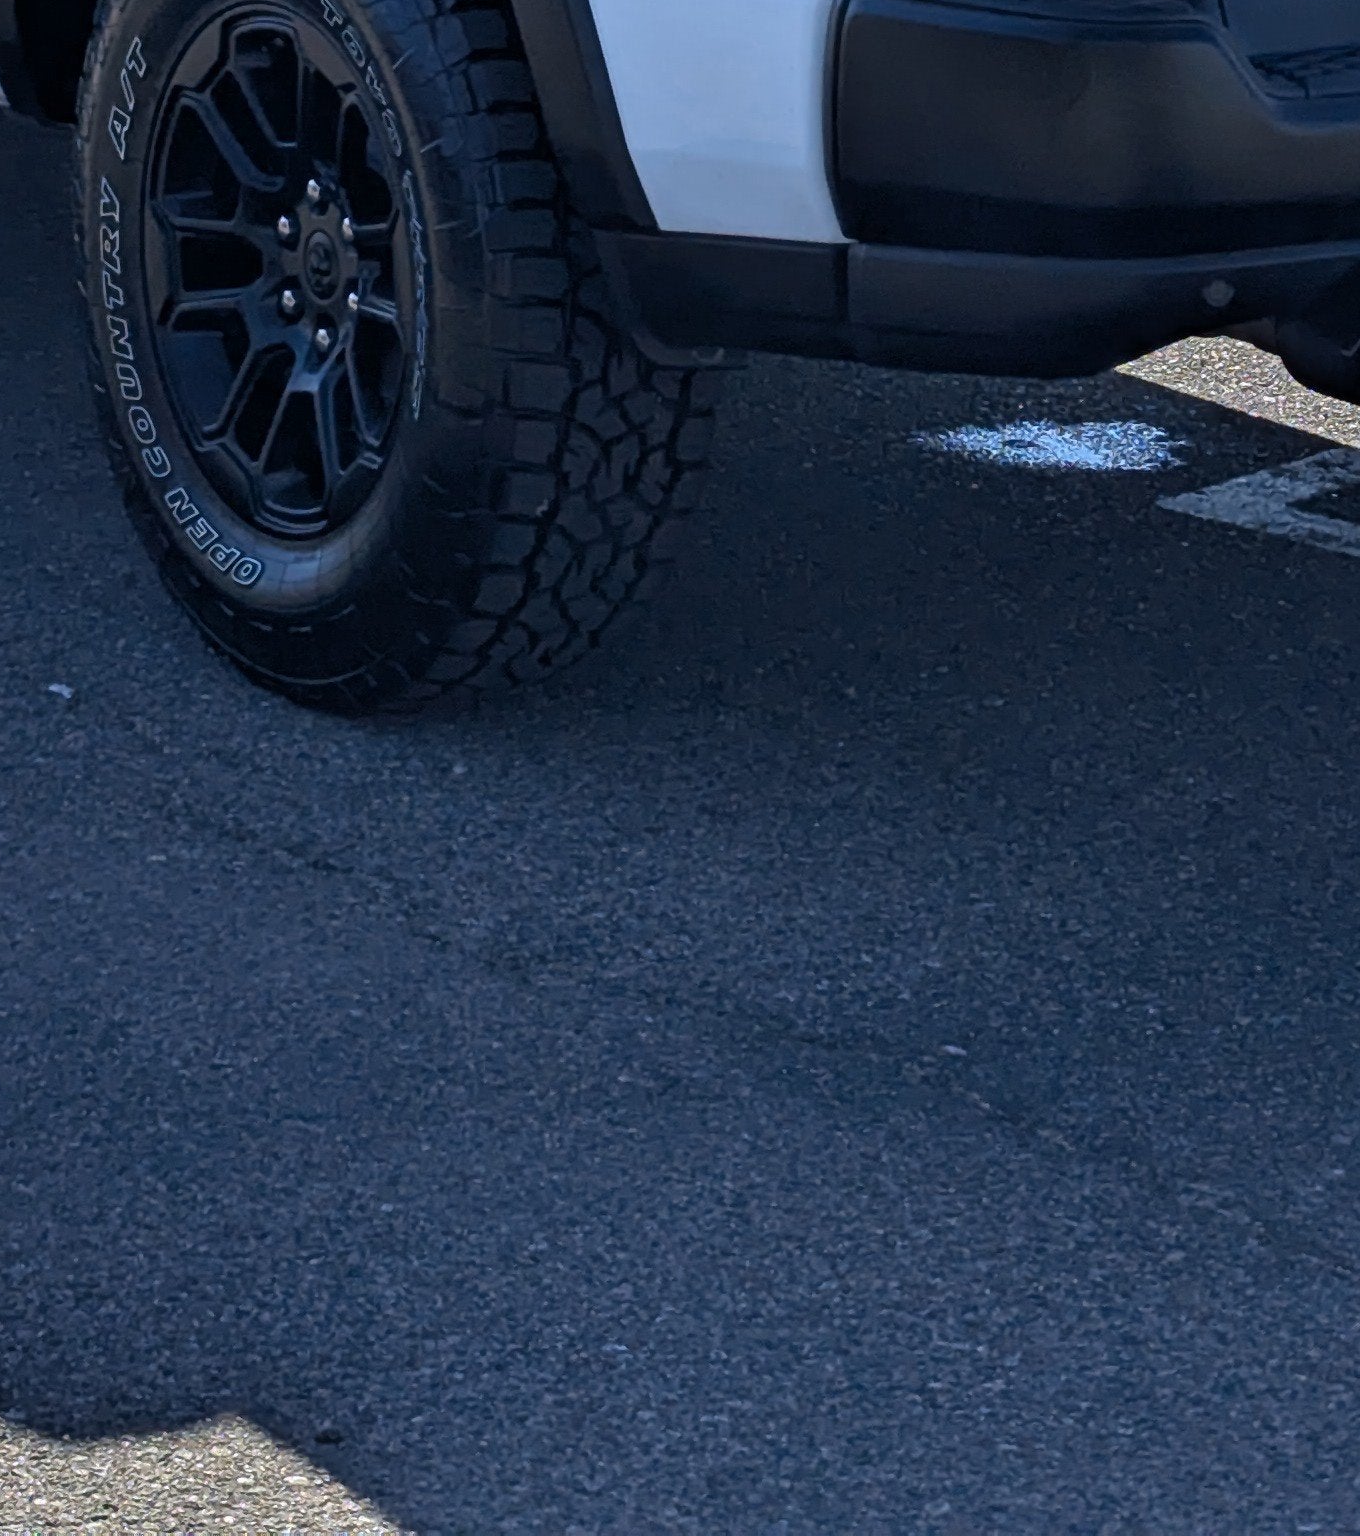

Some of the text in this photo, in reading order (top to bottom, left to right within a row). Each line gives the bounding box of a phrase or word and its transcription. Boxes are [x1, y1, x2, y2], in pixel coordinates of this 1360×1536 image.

[97, 36, 265, 588] OPEN COUNTRY A/T
